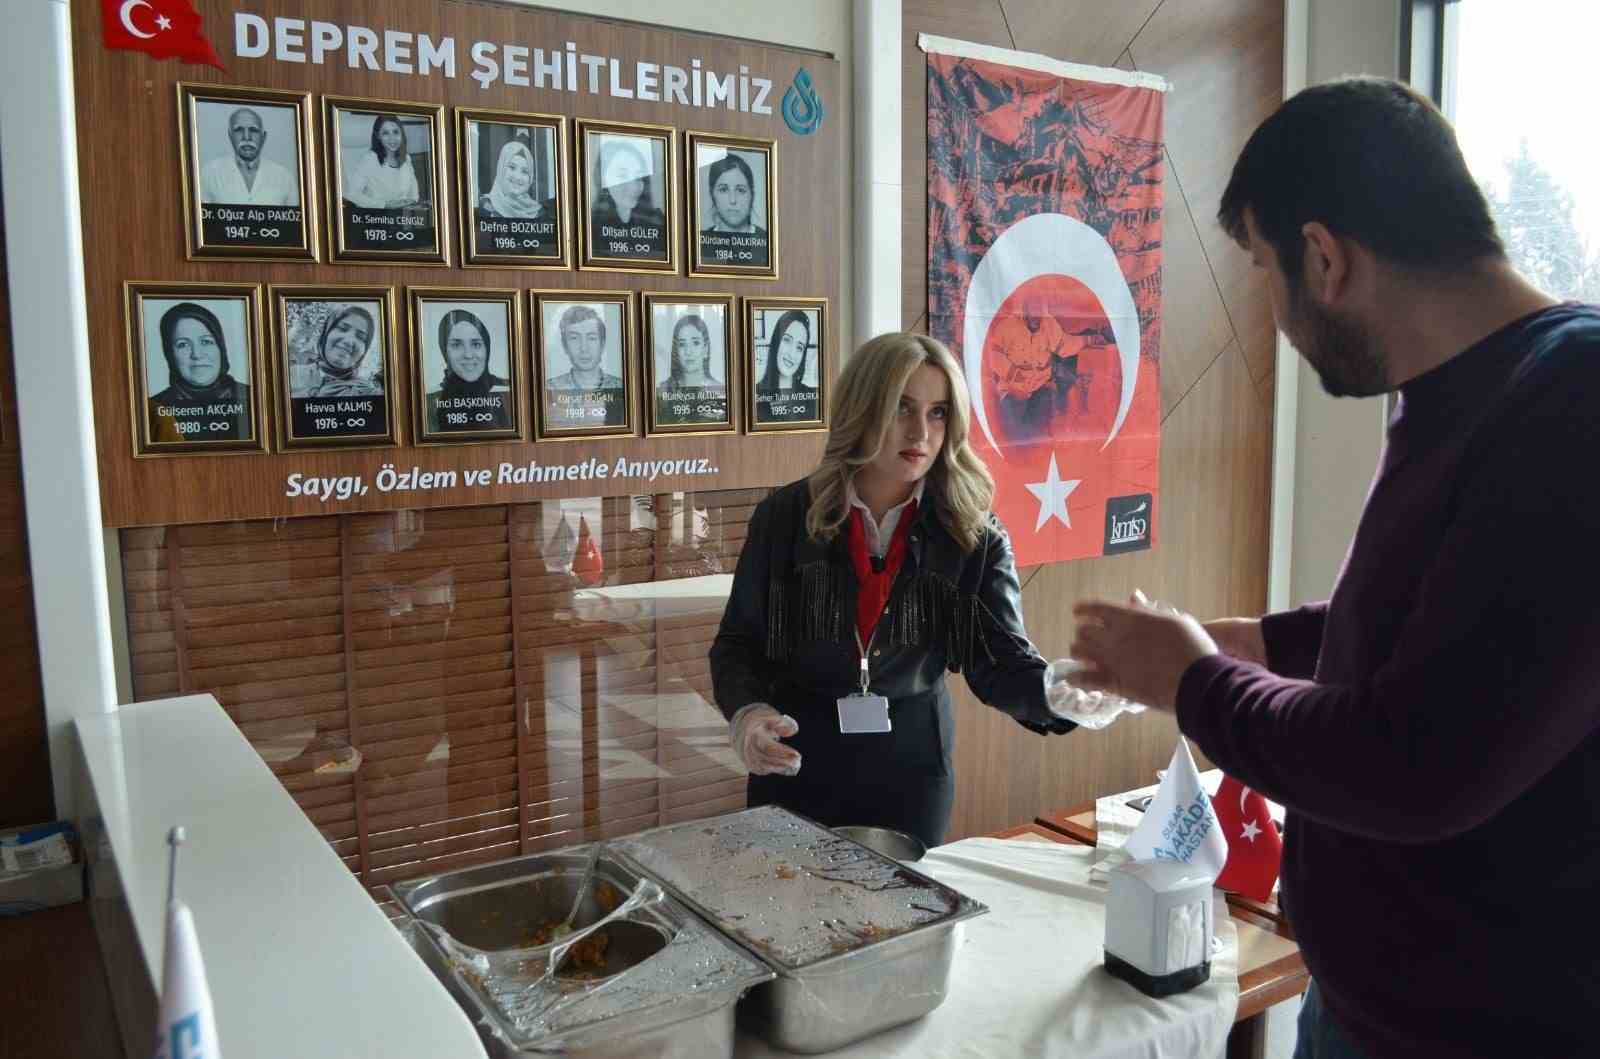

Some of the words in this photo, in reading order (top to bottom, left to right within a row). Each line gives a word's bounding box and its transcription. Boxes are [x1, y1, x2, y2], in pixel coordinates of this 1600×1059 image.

[234, 12, 456, 79] DEPREM
[470, 41, 773, 116] ŞEHİTLERİMİZ
[201, 208, 215, 219] Dr.
[218, 209, 245, 221] Oğuz
[247, 210, 265, 222] Alp
[267, 209, 302, 222] PAKÖZ
[225, 226, 250, 238] 1947
[480, 221, 508, 233] Defne
[511, 222, 555, 234] BOZKURT
[630, 226, 659, 240] GÜLER
[364, 229, 387, 241] 1978
[495, 237, 516, 249] 1996
[608, 241, 629, 253] 1996
[158, 405, 204, 417] Gülseren
[207, 403, 243, 417] AKÇAM
[305, 402, 336, 414] Havva
[314, 417, 338, 430] 1976
[447, 412, 468, 424] 1985
[174, 421, 201, 434] 1980
[285, 473, 369, 502] Saygı,
[376, 463, 457, 492] Özlem
[463, 470, 493, 486] ve
[497, 457, 609, 485] Rahmetle
[611, 456, 720, 482] Anıyoruz..
